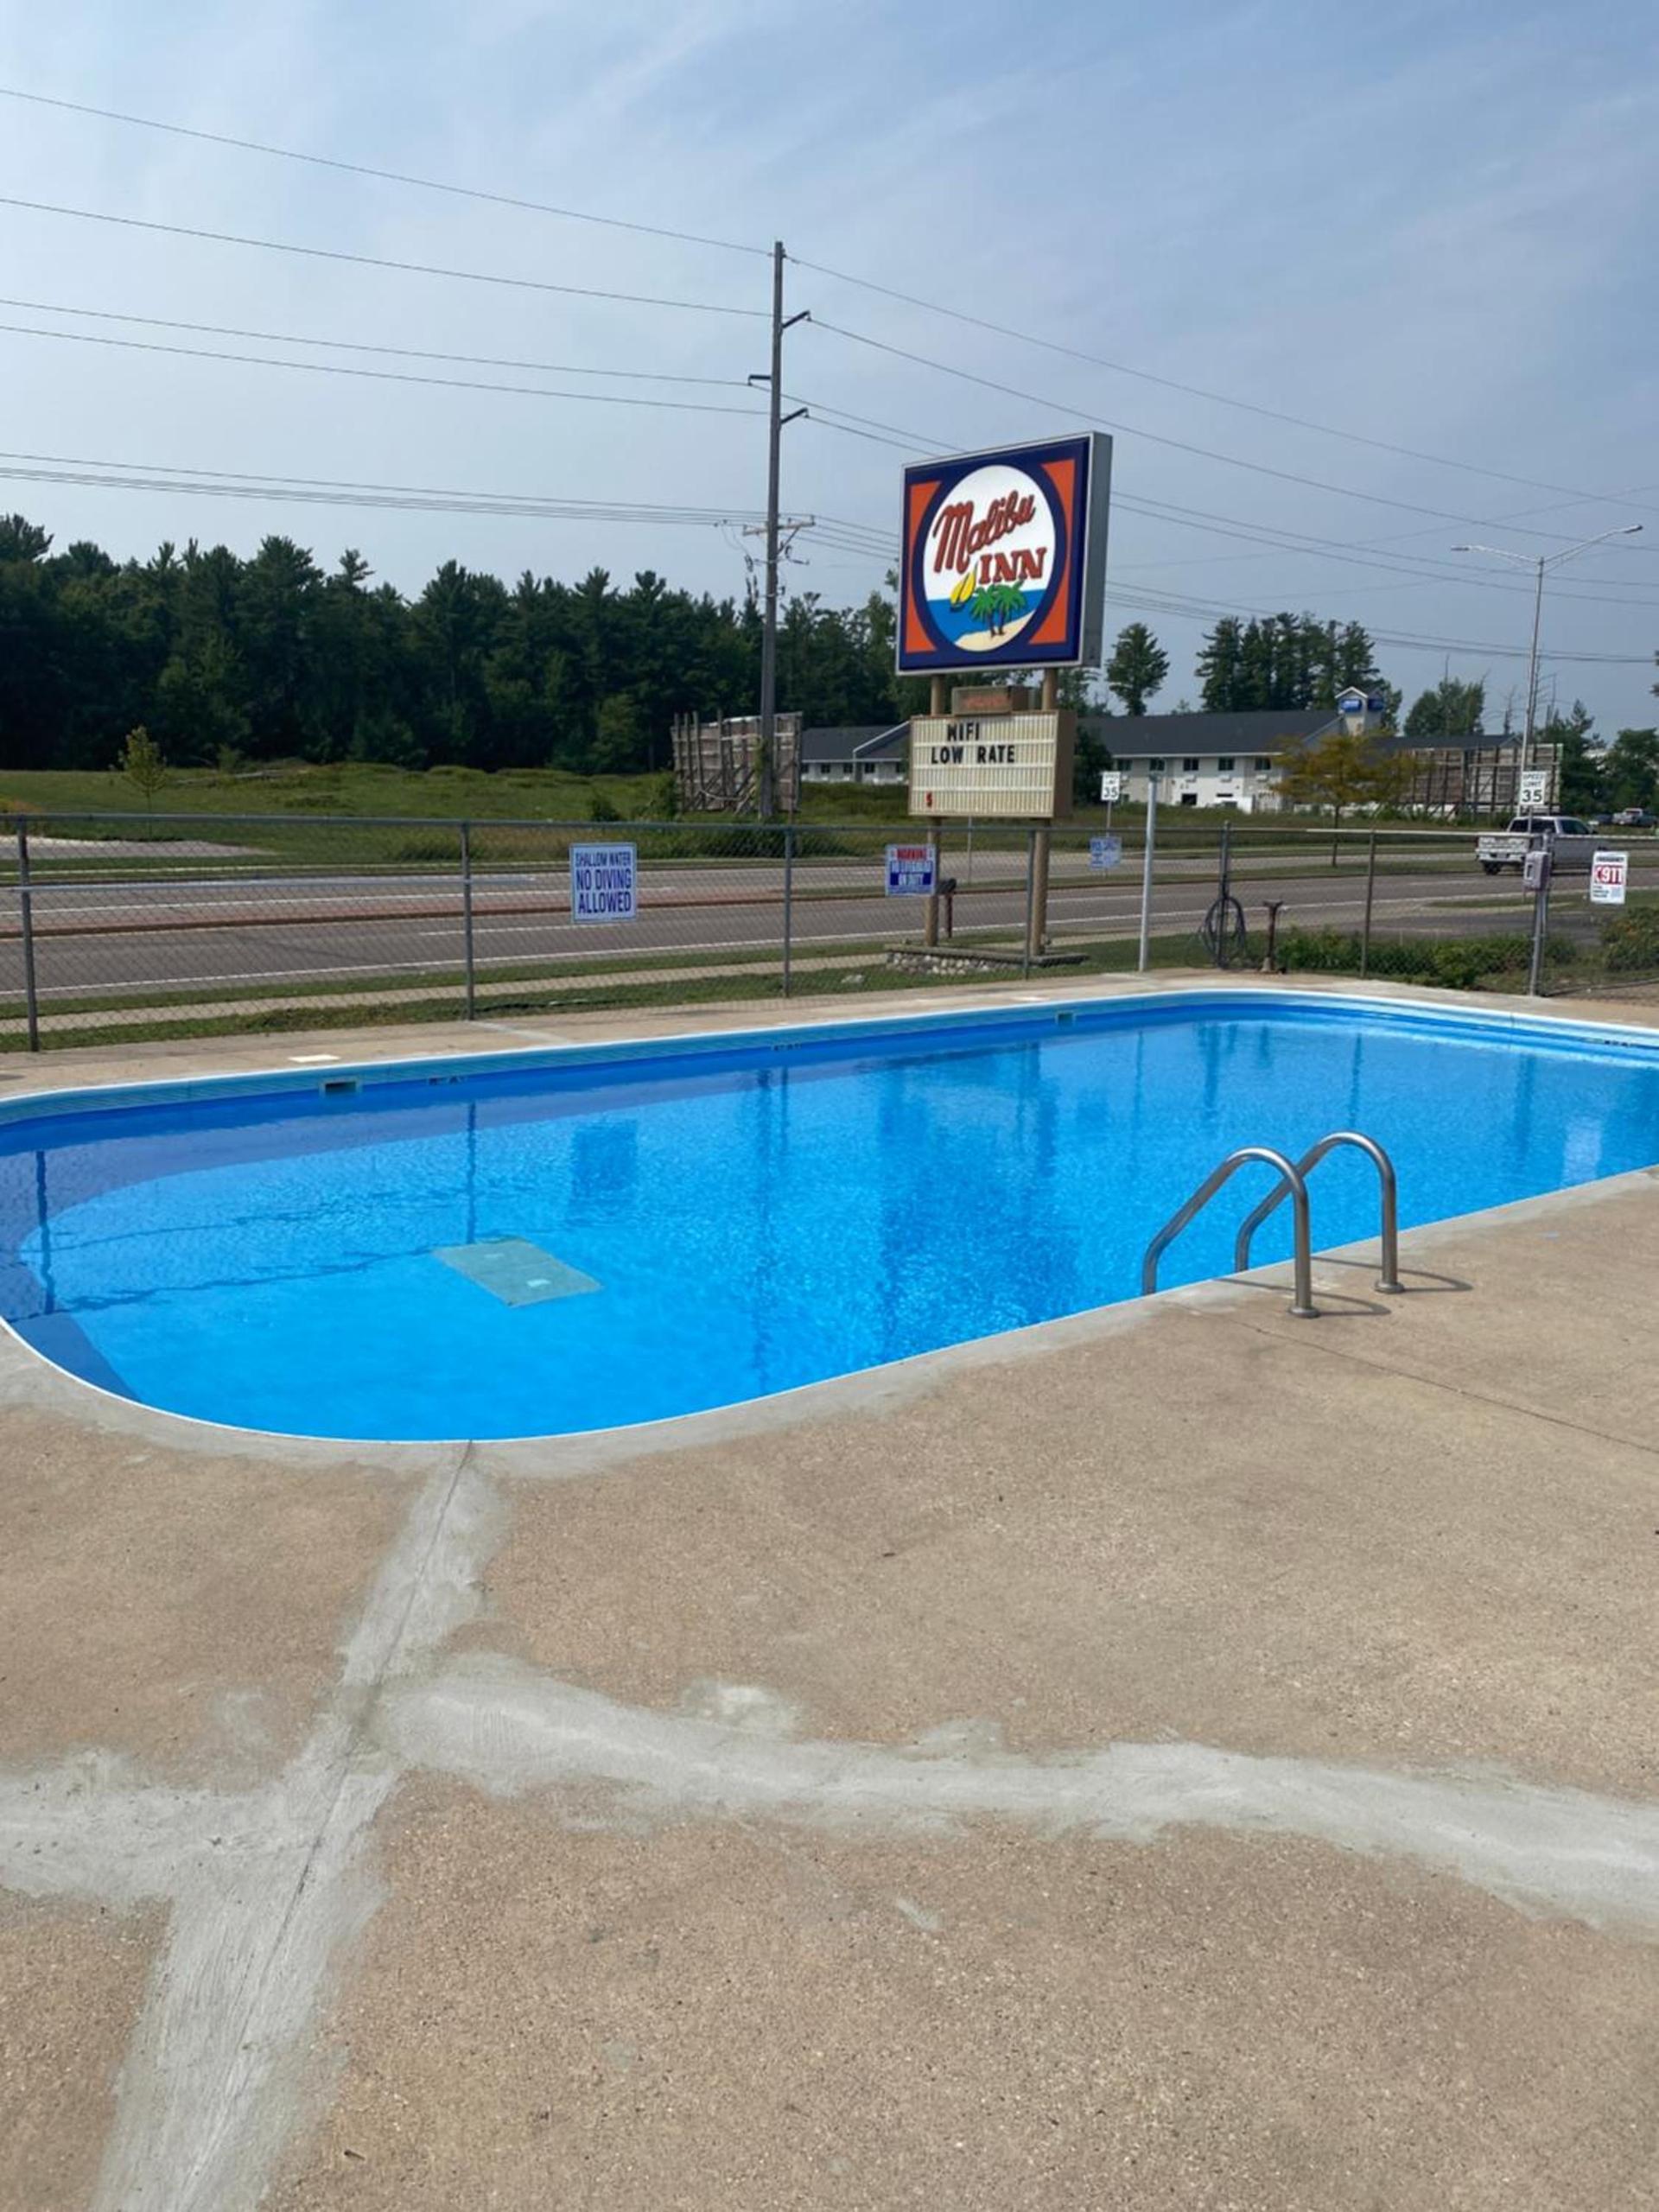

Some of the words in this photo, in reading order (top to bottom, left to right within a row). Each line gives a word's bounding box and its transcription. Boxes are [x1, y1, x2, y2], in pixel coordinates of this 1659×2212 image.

[933, 490, 1036, 574] Malibu
[979, 547, 1047, 584] INN
[931, 746, 963, 764] LOW
[977, 745, 1015, 763] RATE
[1522, 789, 1542, 803] 35
[608, 851, 631, 866] WATER
[576, 869, 591, 890] NO
[595, 868, 632, 889] DIVING
[1603, 867, 1623, 883] 911
[578, 892, 632, 913] ALLOWED
